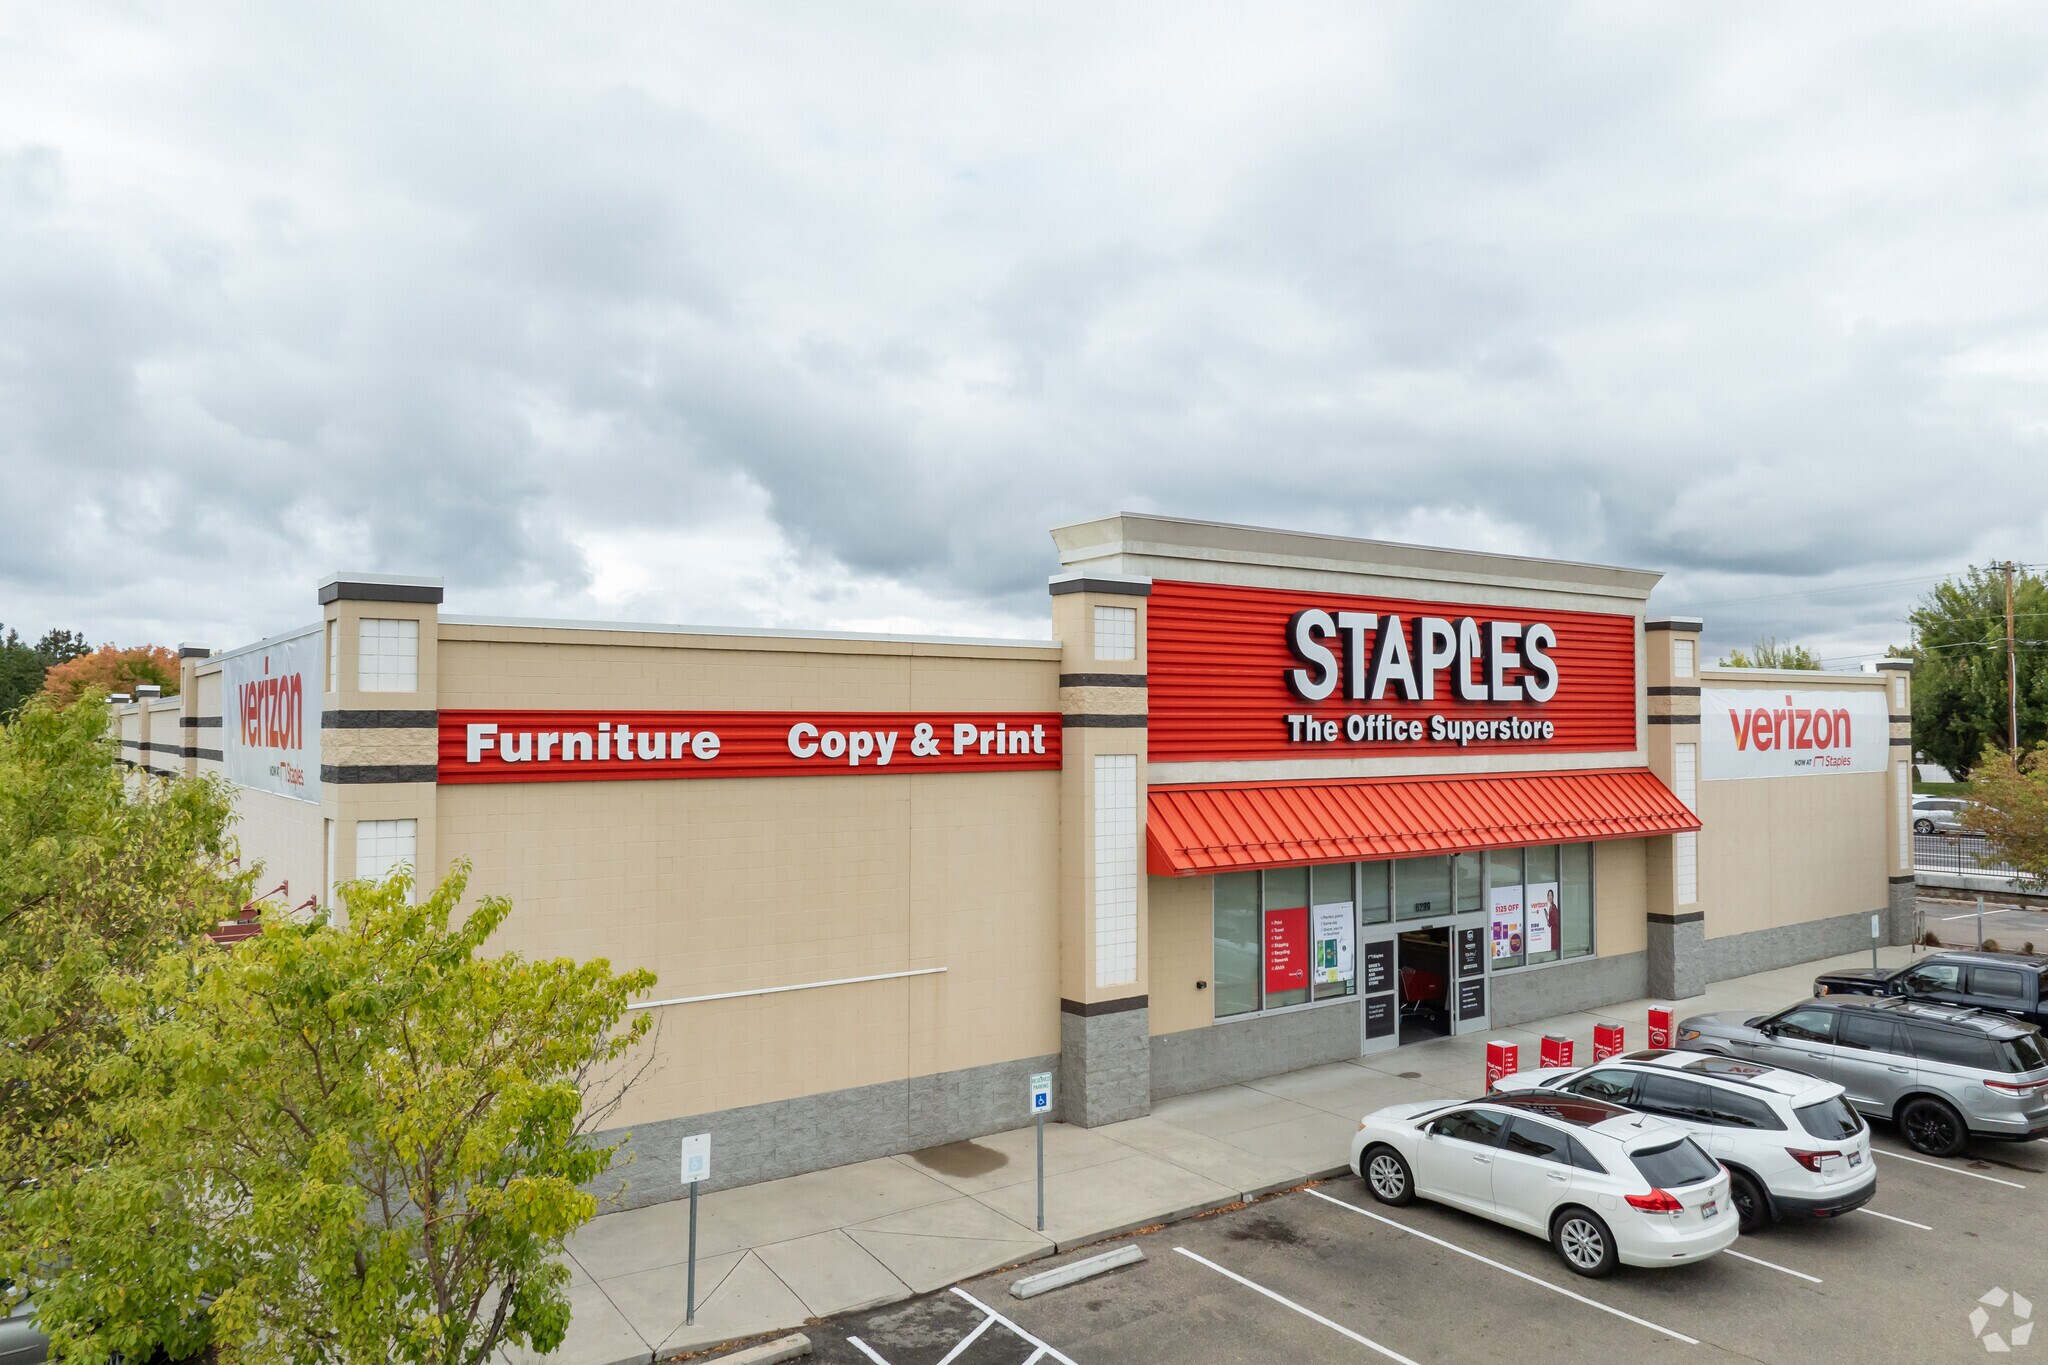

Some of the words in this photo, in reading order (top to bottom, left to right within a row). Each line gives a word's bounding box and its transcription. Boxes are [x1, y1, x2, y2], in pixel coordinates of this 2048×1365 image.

[1286, 608, 1559, 702] STAPLES
[239, 656, 302, 751] verizon
[1728, 695, 1851, 751] verizon
[466, 722, 721, 763] Furniture
[787, 722, 898, 766] Copy
[910, 722, 941, 757] &
[953, 722, 1046, 755] Print
[1287, 714, 1338, 741] The
[1346, 714, 1423, 742] Office
[1430, 715, 1554, 746] Superstore
[1825, 755, 1851, 769] Staples
[1531, 901, 1548, 909] verizon
